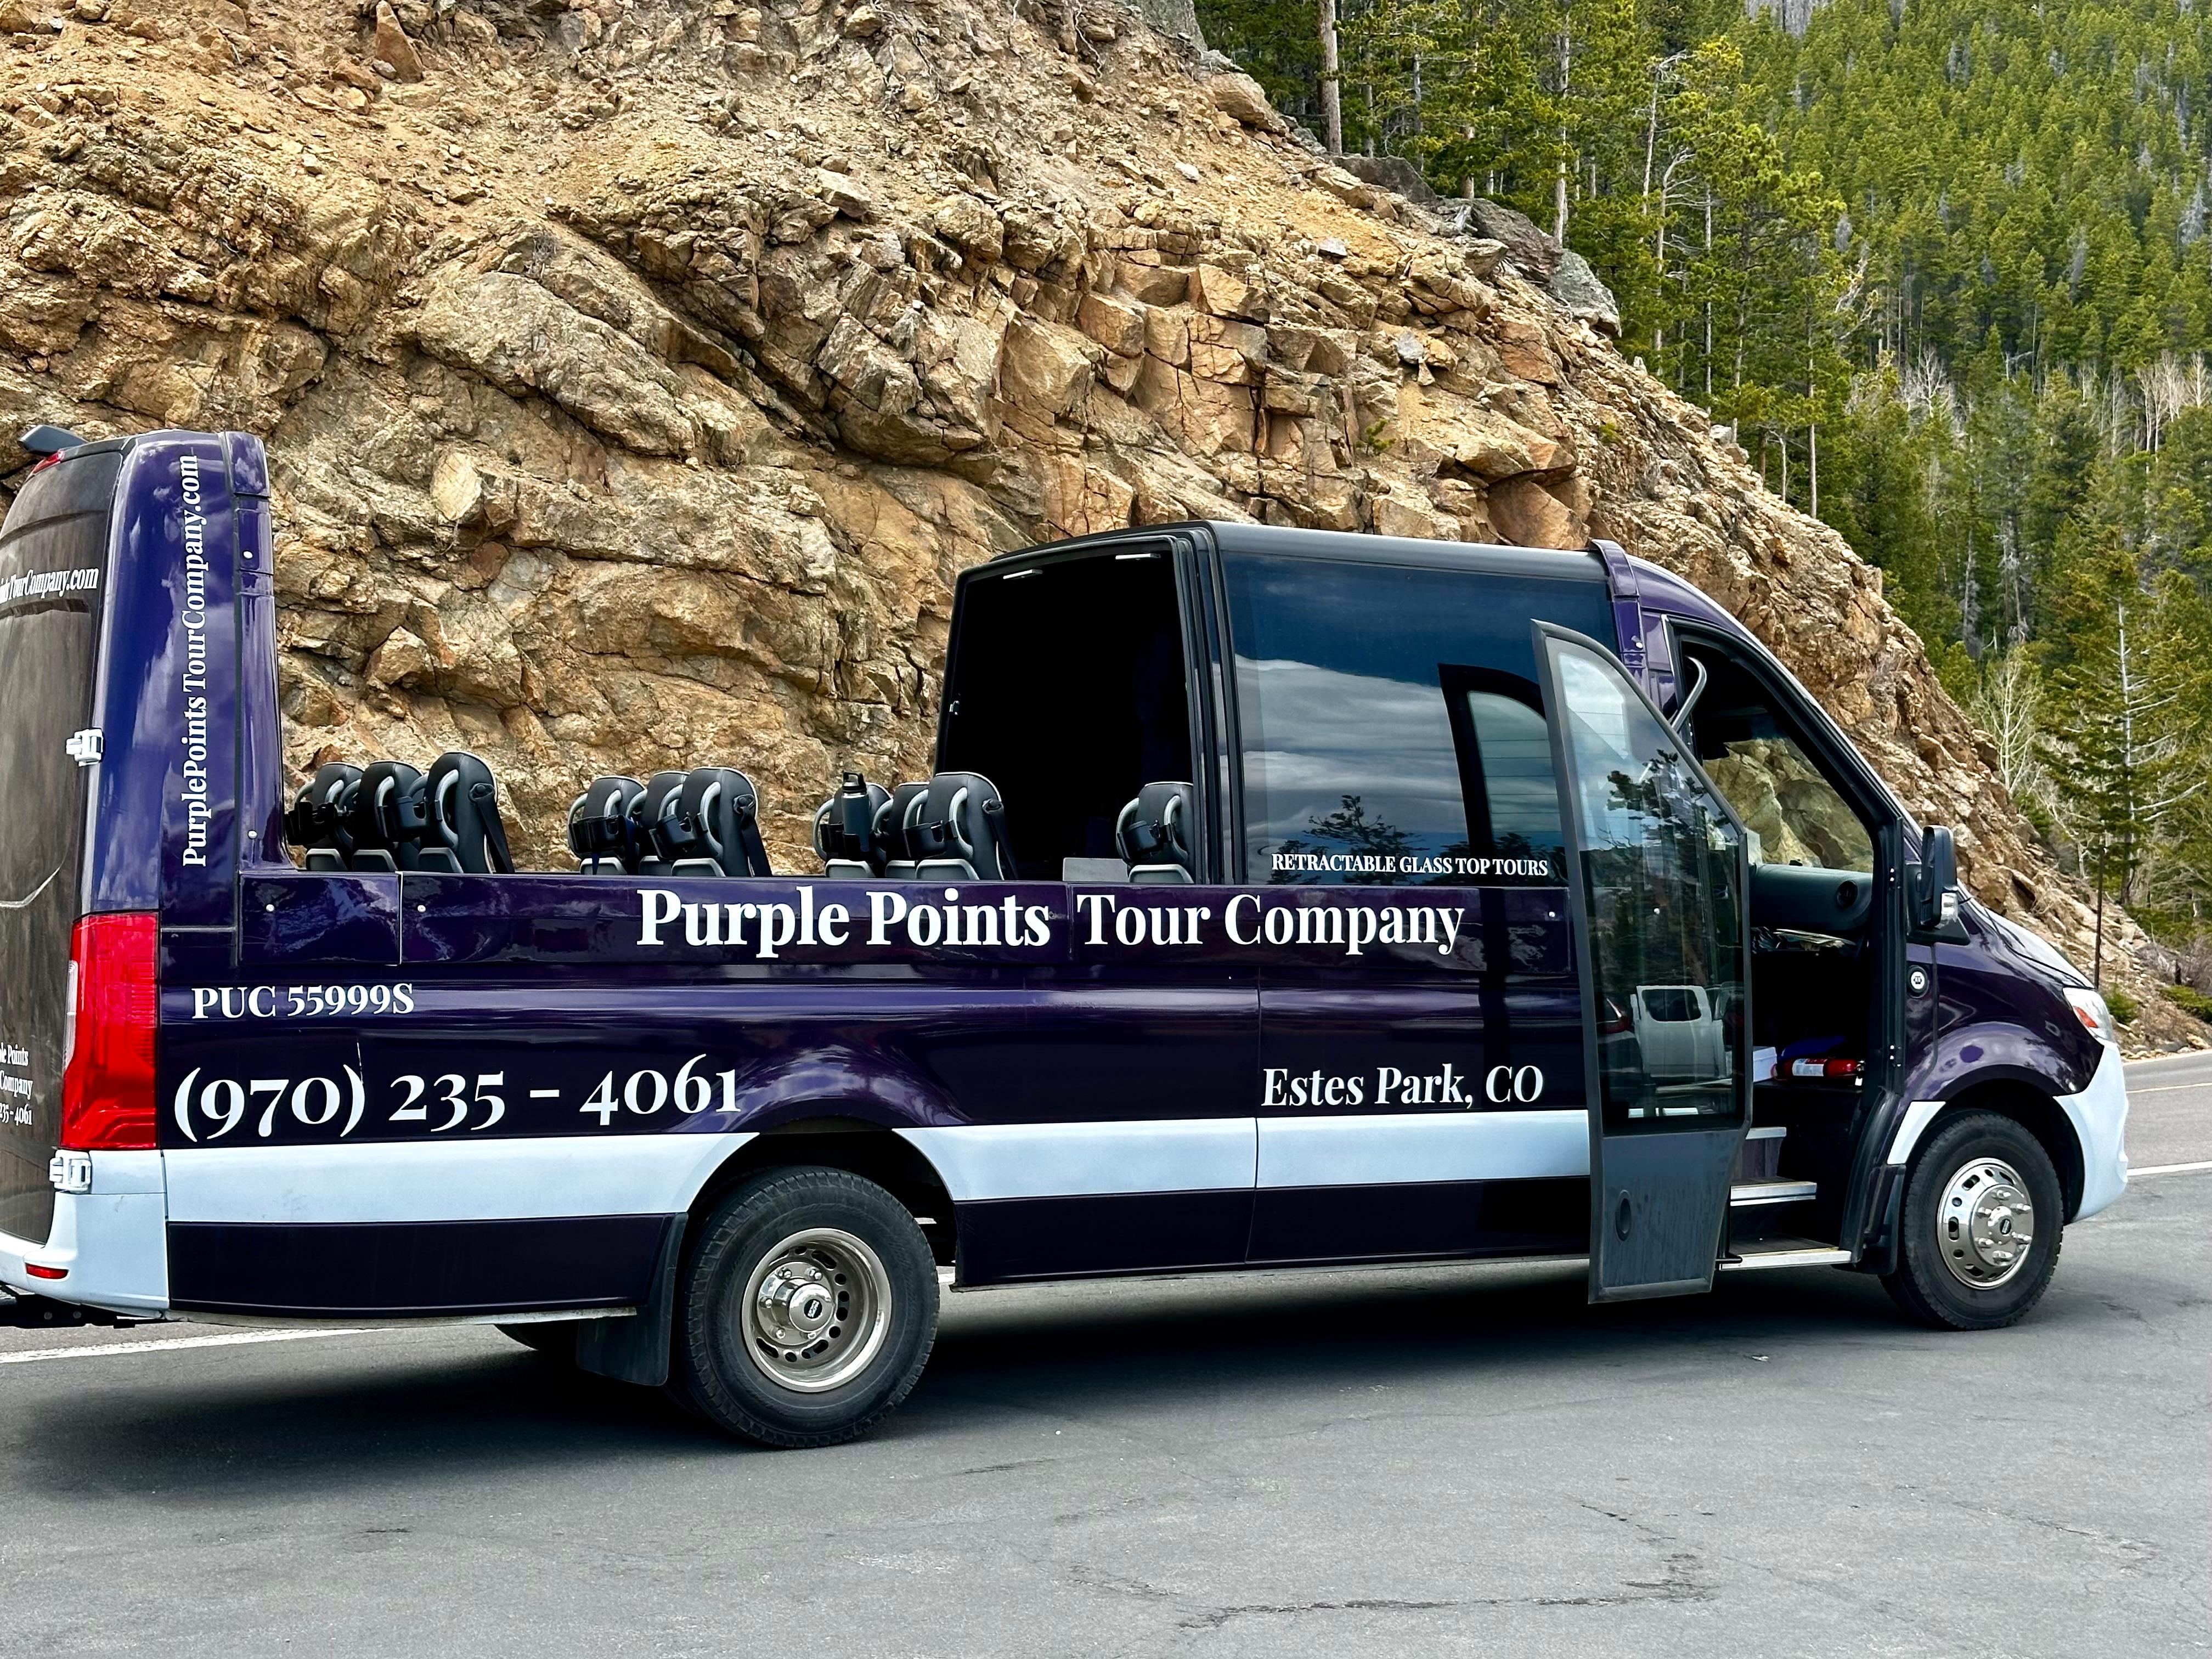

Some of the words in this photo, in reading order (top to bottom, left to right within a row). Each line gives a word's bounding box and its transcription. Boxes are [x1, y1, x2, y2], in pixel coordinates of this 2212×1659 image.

[1272, 854, 1396, 872] RETRACTABLE
[1400, 856, 1453, 874] GLASS
[1455, 858, 1490, 874] TOP
[1492, 859, 1548, 876] TOURS
[637, 885, 850, 958] Purple
[866, 887, 1050, 946] Points
[1076, 894, 1211, 945] Tour
[1225, 894, 1465, 955] Company
[191, 986, 276, 1019] PUC
[287, 983, 414, 1017] 55999S
[7, 1044, 29, 1066] Points
[174, 1064, 365, 1142] (970)
[388, 1071, 505, 1132] 235
[579, 1053, 741, 1126] 4061
[1261, 1069, 1364, 1106] Estes
[1375, 1063, 1473, 1109] Park,
[1486, 1065, 1544, 1104] CO
[14, 1104, 32, 1126] 4061
